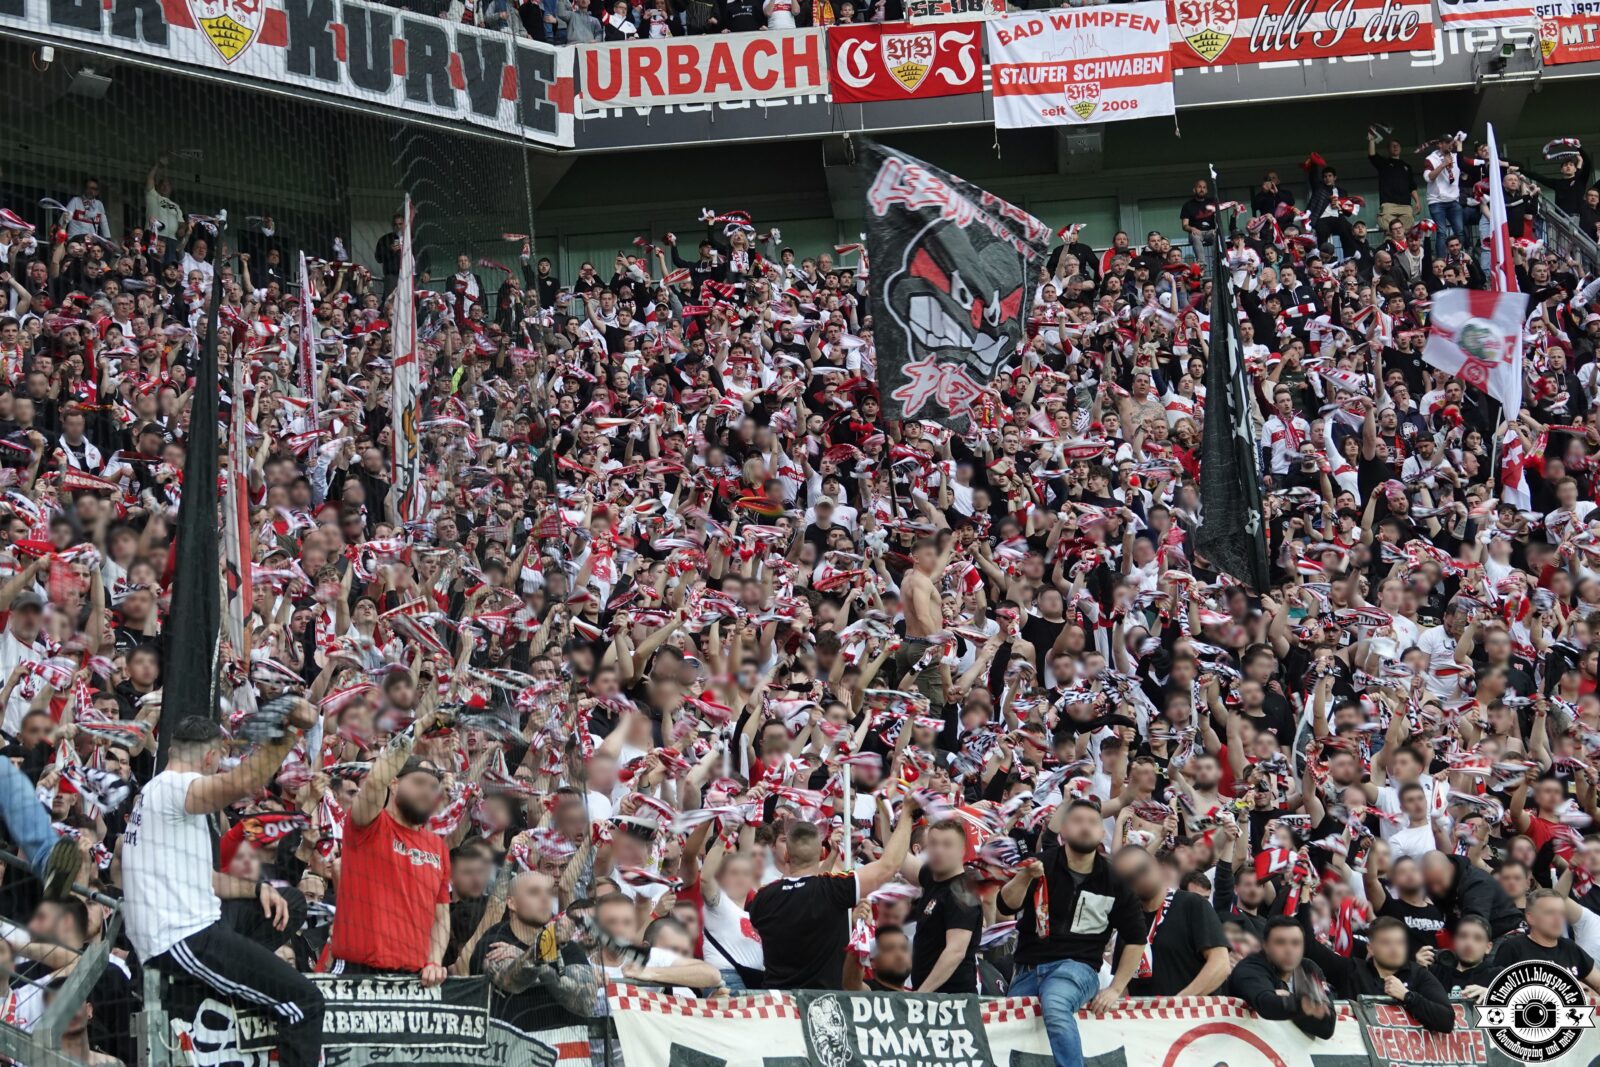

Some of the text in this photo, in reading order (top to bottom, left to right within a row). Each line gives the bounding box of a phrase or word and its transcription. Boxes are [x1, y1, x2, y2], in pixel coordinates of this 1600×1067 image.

[1537, 2, 1600, 16] SEIT 1997
[997, 12, 1161, 46] BAD WIMPFEN
[1250, 0, 1312, 53] till
[1361, 0, 1419, 43] die
[837, 38, 877, 88] C
[887, 37, 932, 60] VfB
[285, 0, 558, 136] KURVE
[586, 34, 821, 101] URBACH
[1000, 65, 1067, 85] STAUFER
[1074, 56, 1163, 81] SCHWABEN
[1066, 83, 1099, 101] VfB
[1042, 100, 1138, 117] seit 2008
[357, 979, 441, 1000] ALLEN
[407, 1011, 485, 1038] ULTRAS
[850, 996, 968, 1026] DU BIST
[855, 1025, 979, 1058] IMMER
[1366, 1025, 1487, 1063] VERBANNTE
